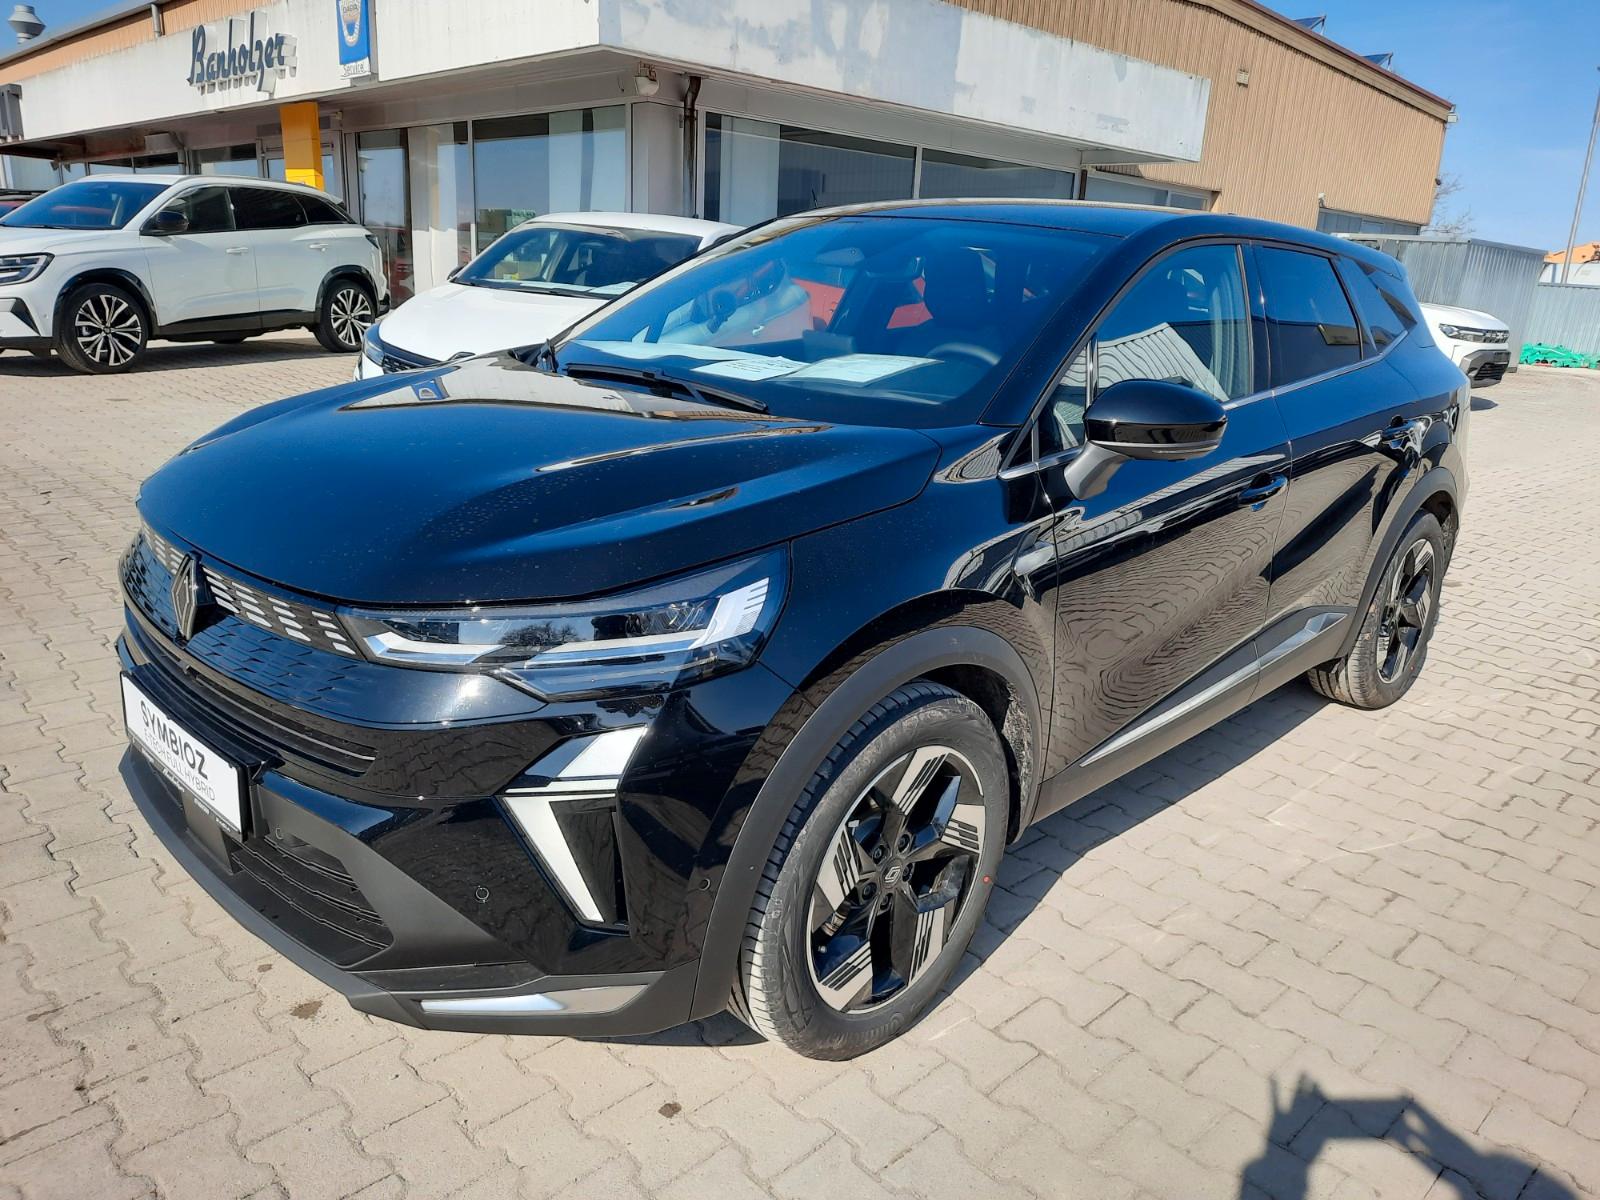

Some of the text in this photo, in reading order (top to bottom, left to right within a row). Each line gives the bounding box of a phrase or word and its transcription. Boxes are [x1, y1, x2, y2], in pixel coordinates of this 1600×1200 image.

[186, 11, 285, 92] Banholzer
[140, 700, 208, 780] SYMBIOZ
[184, 766, 216, 801] HYBRID
